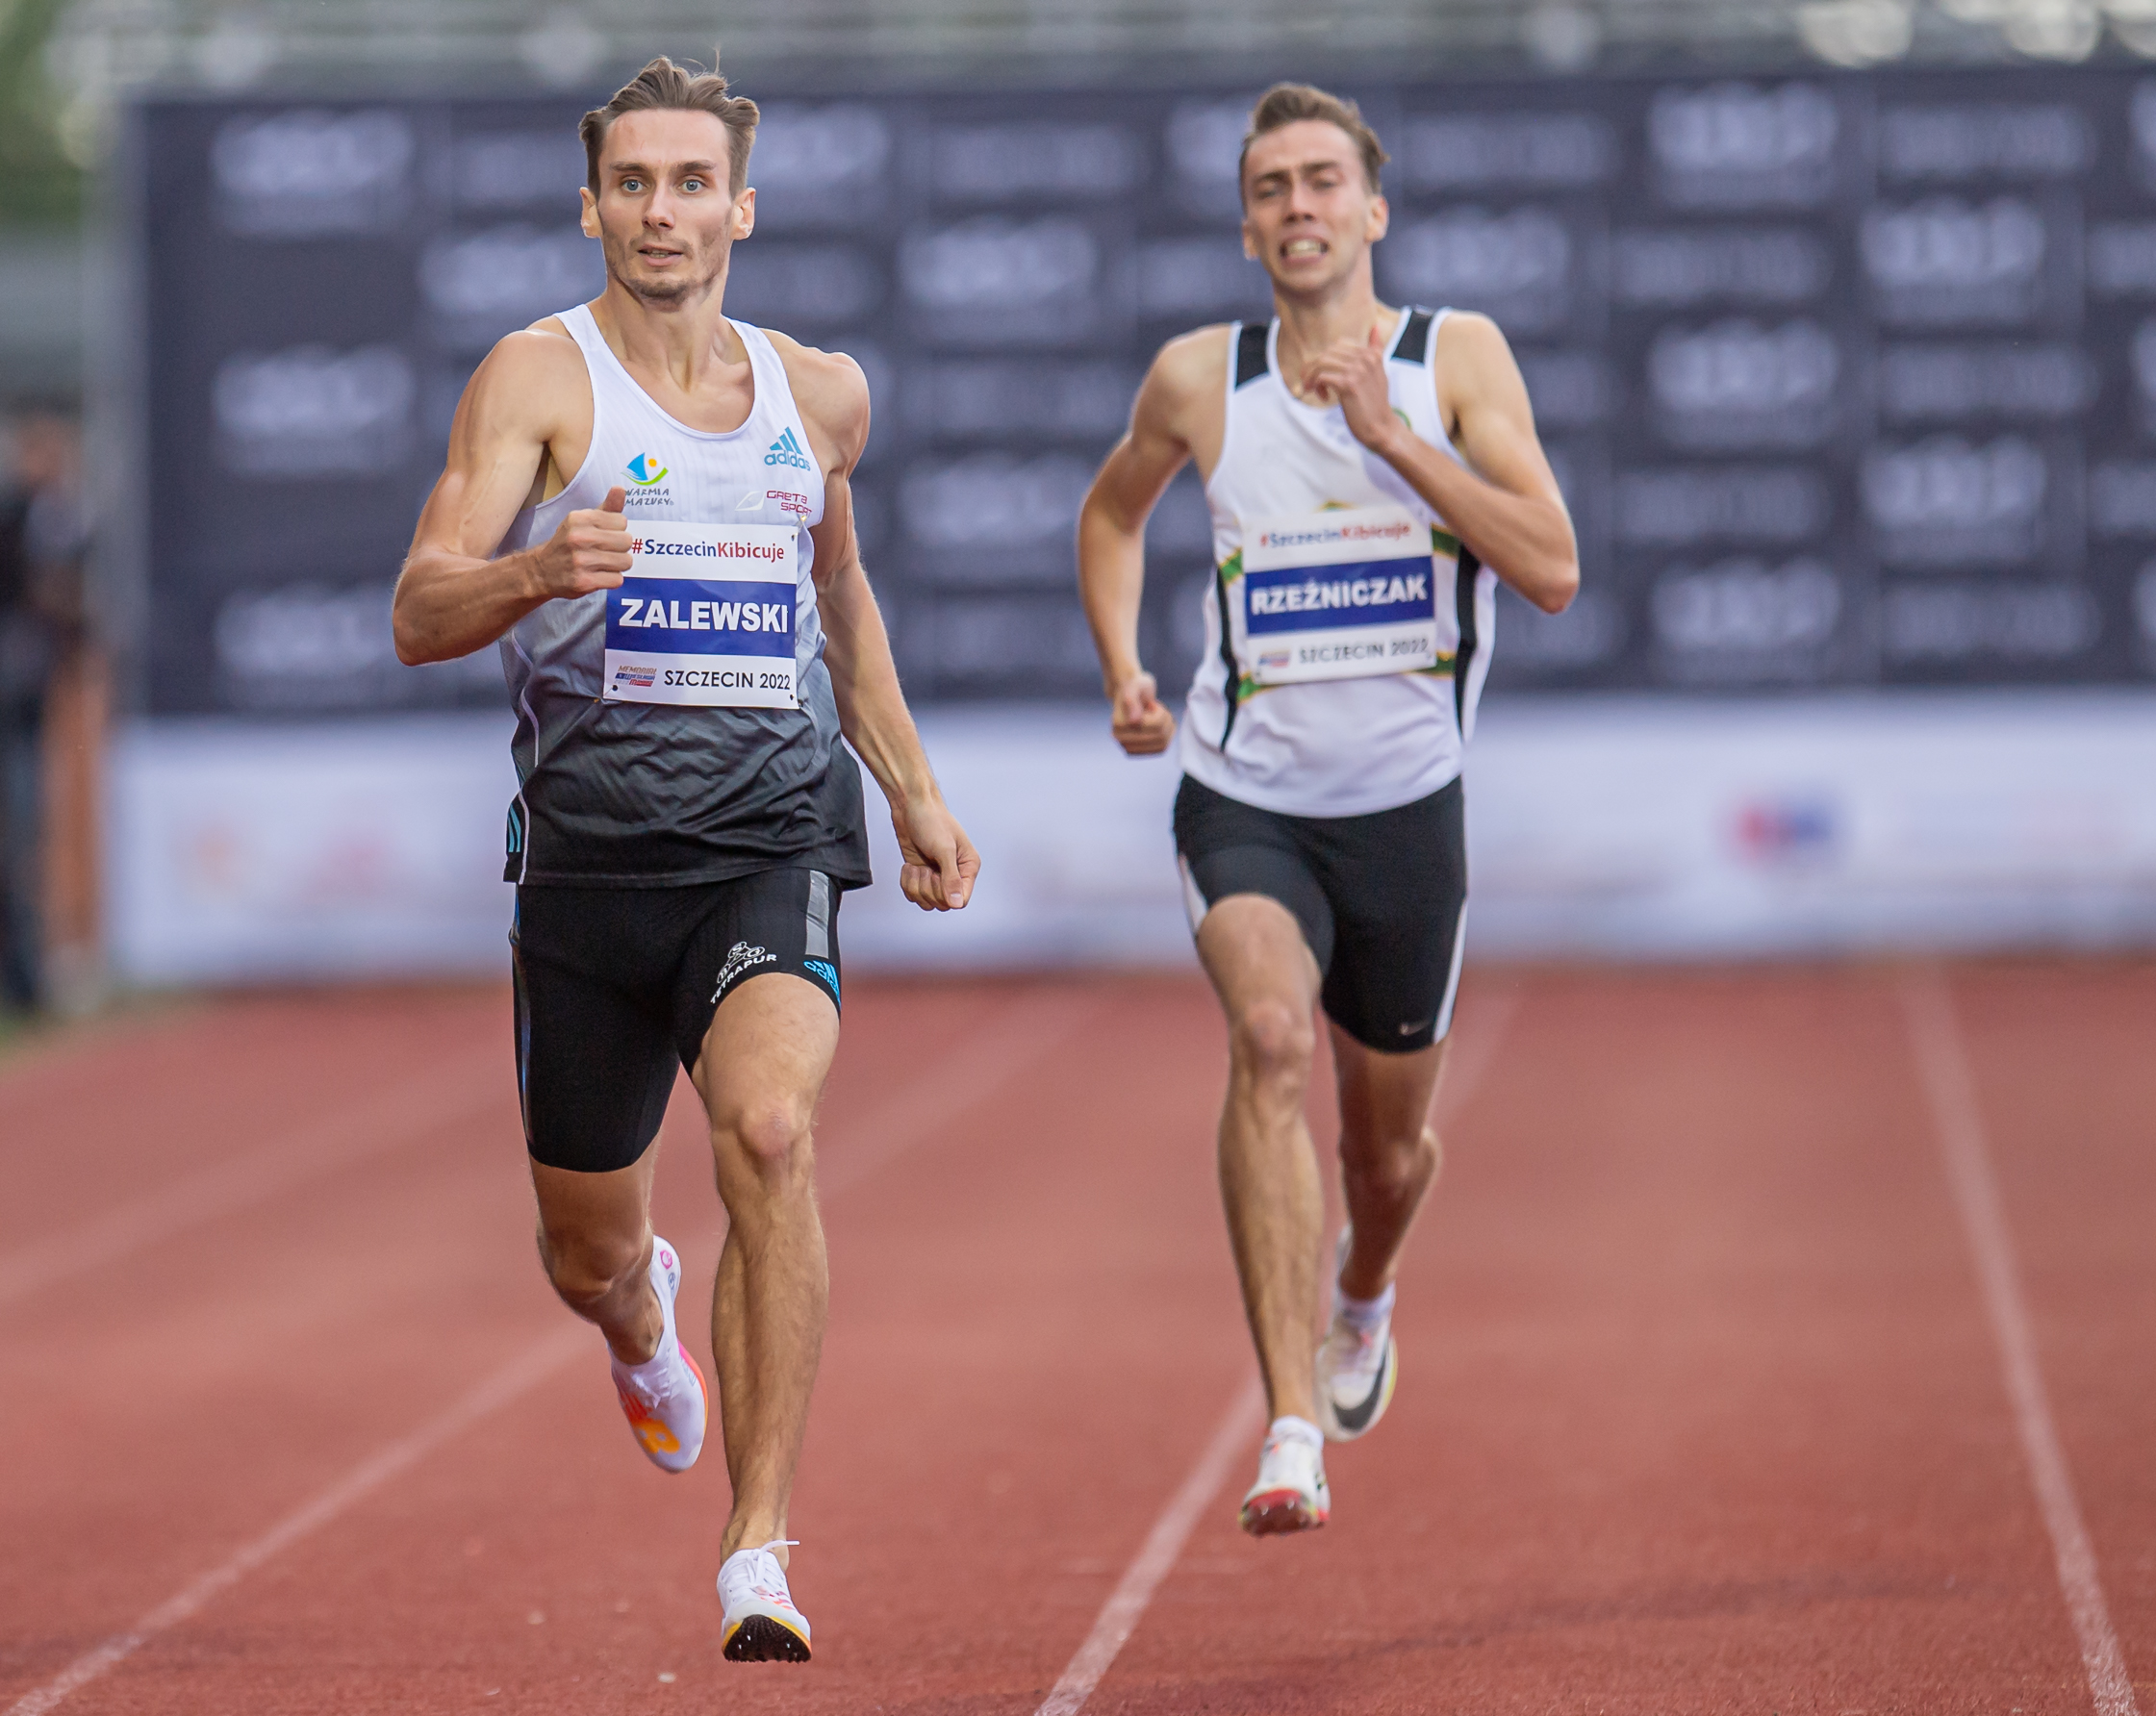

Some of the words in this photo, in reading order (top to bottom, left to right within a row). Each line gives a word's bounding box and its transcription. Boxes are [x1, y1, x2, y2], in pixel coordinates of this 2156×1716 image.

[764, 450, 811, 471] adidas
[624, 488, 670, 496] WARMIA
[631, 538, 785, 564] #SzczecinKibicuje
[619, 597, 789, 634] ZALEWSKI
[1299, 643, 1384, 665] SZCZECIN
[1391, 638, 1430, 657] 2022
[664, 669, 753, 689] SZCZECIN
[759, 673, 791, 691] 2022
[710, 953, 777, 1004] TETRAPUR
